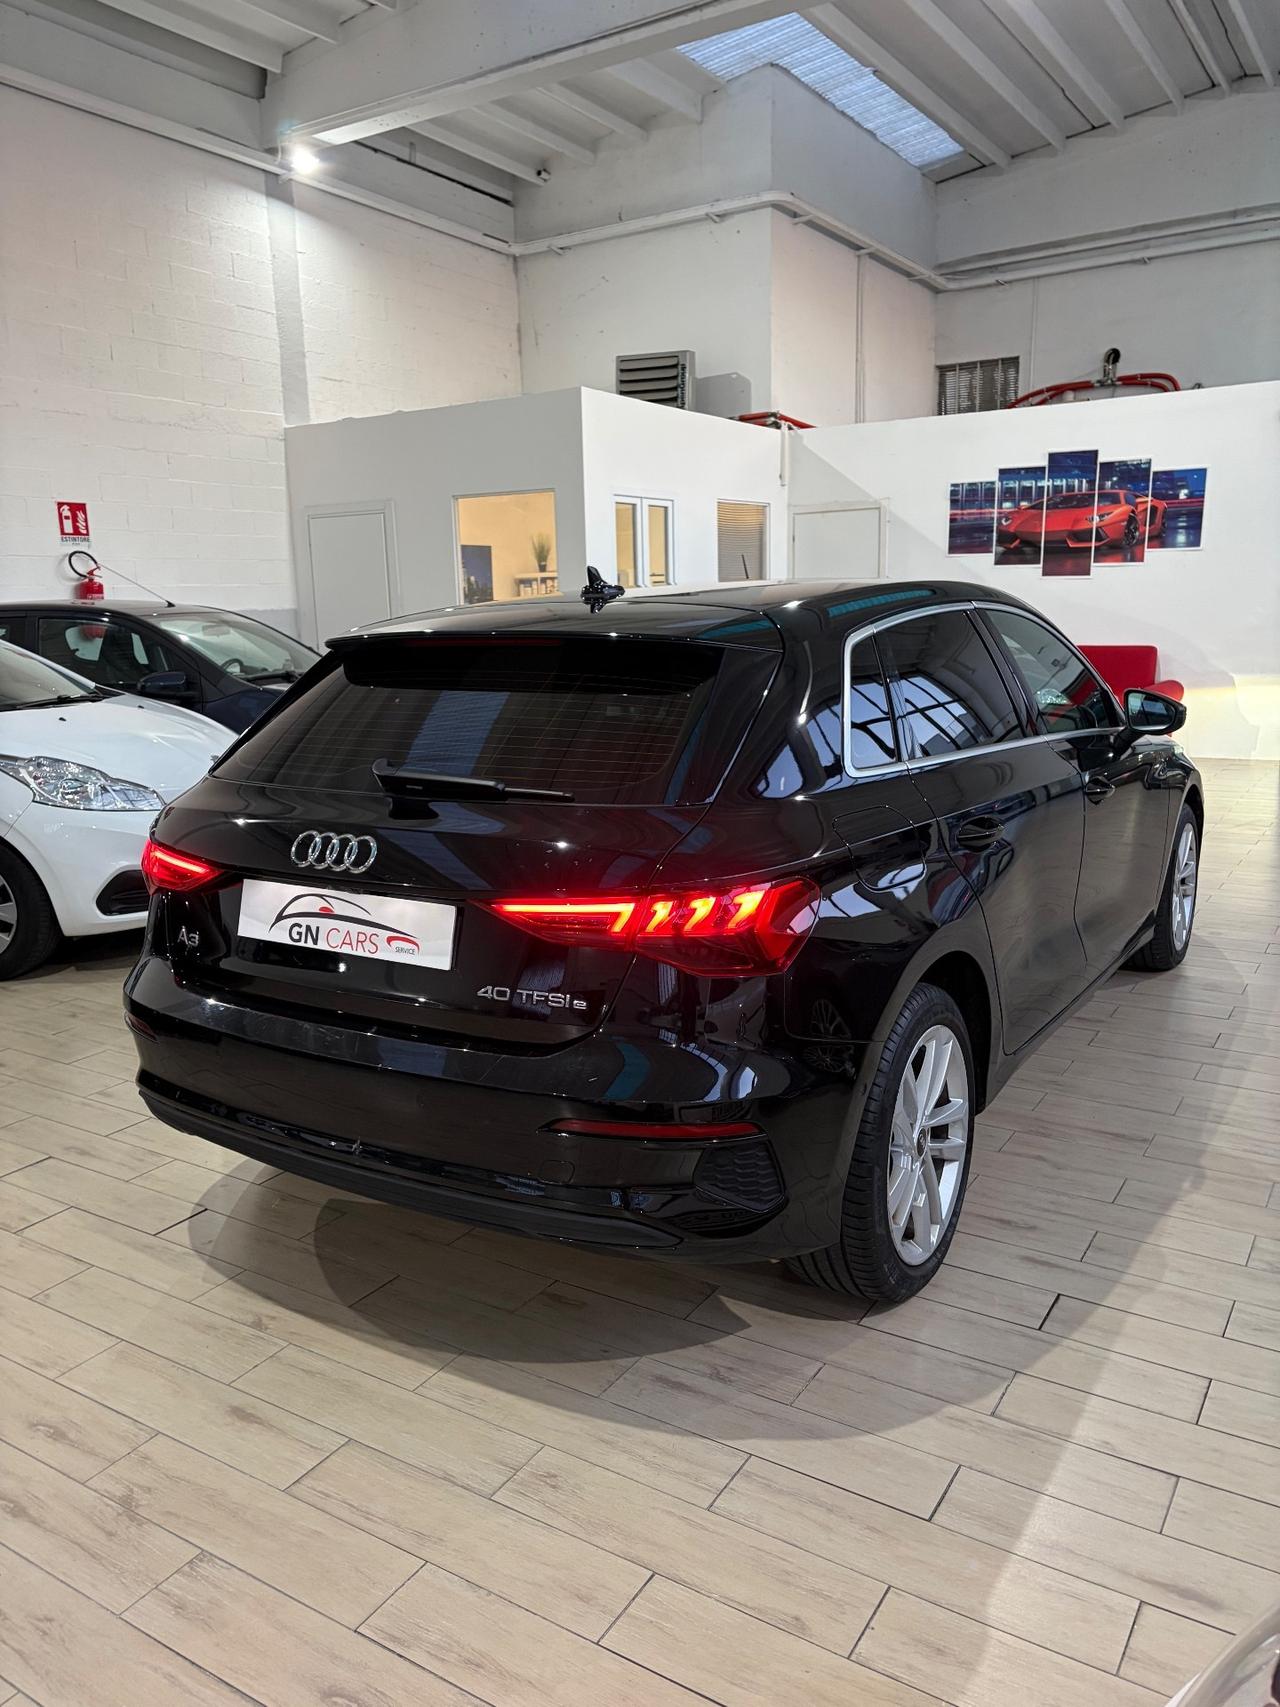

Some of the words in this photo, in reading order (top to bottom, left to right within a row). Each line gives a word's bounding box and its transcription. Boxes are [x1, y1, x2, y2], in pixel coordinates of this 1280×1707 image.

[177, 926, 199, 947] A3
[288, 922, 320, 946] GN
[326, 927, 379, 954] CARS
[395, 946, 415, 955] SERVICE
[477, 985, 510, 1001] 40
